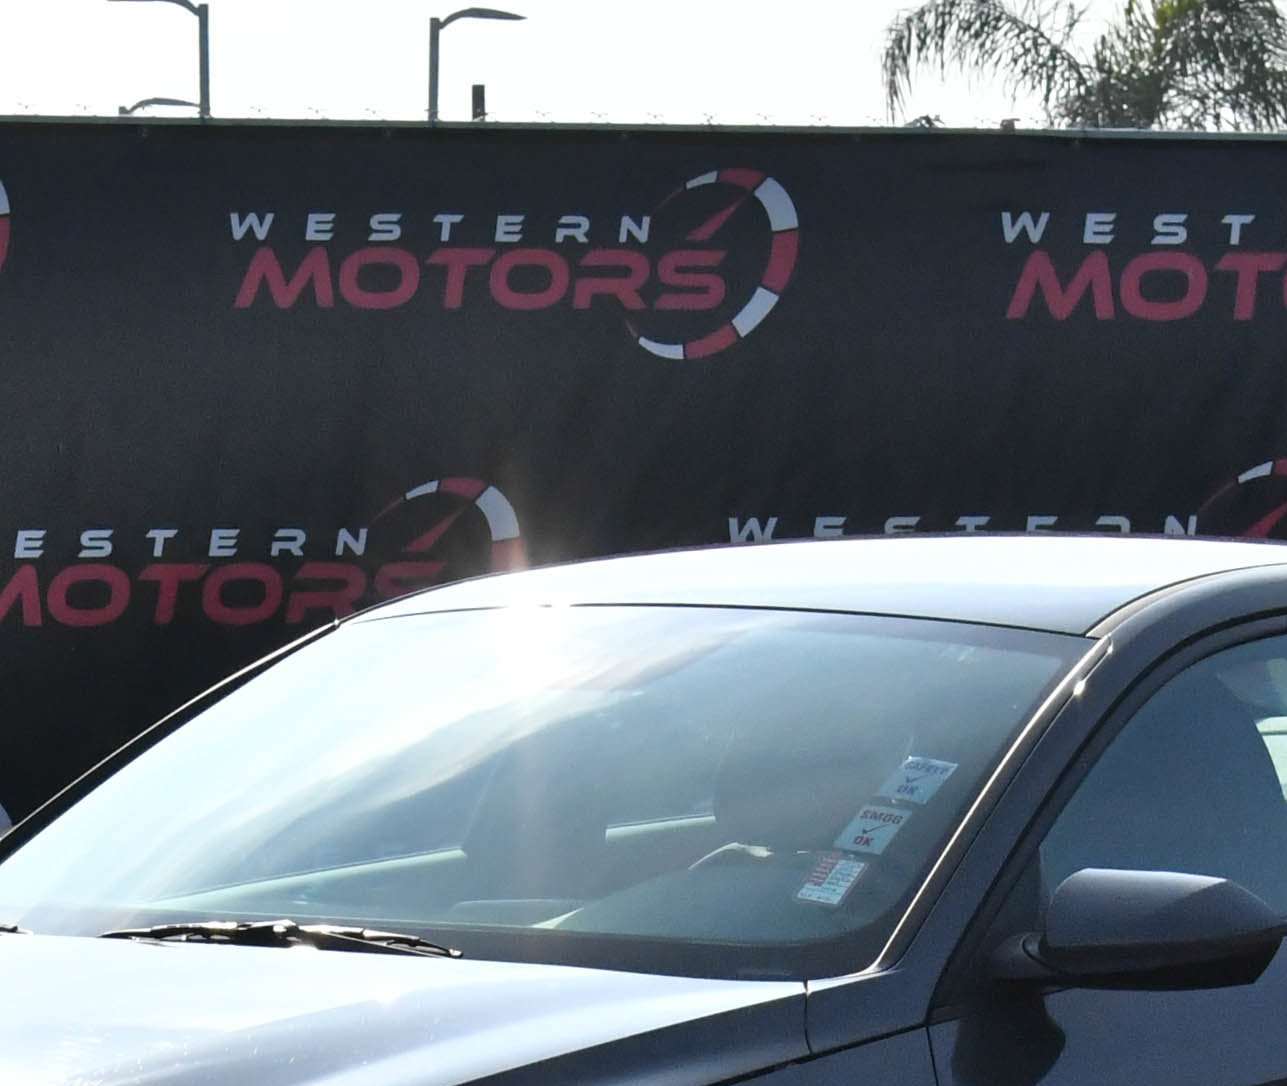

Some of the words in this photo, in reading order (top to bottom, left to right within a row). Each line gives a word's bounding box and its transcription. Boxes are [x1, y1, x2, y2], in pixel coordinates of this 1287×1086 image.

[230, 212, 651, 243] WESTERN
[234, 247, 726, 309] MOTORS
[859, 808, 904, 826] SMOG
[852, 834, 875, 847] OK
